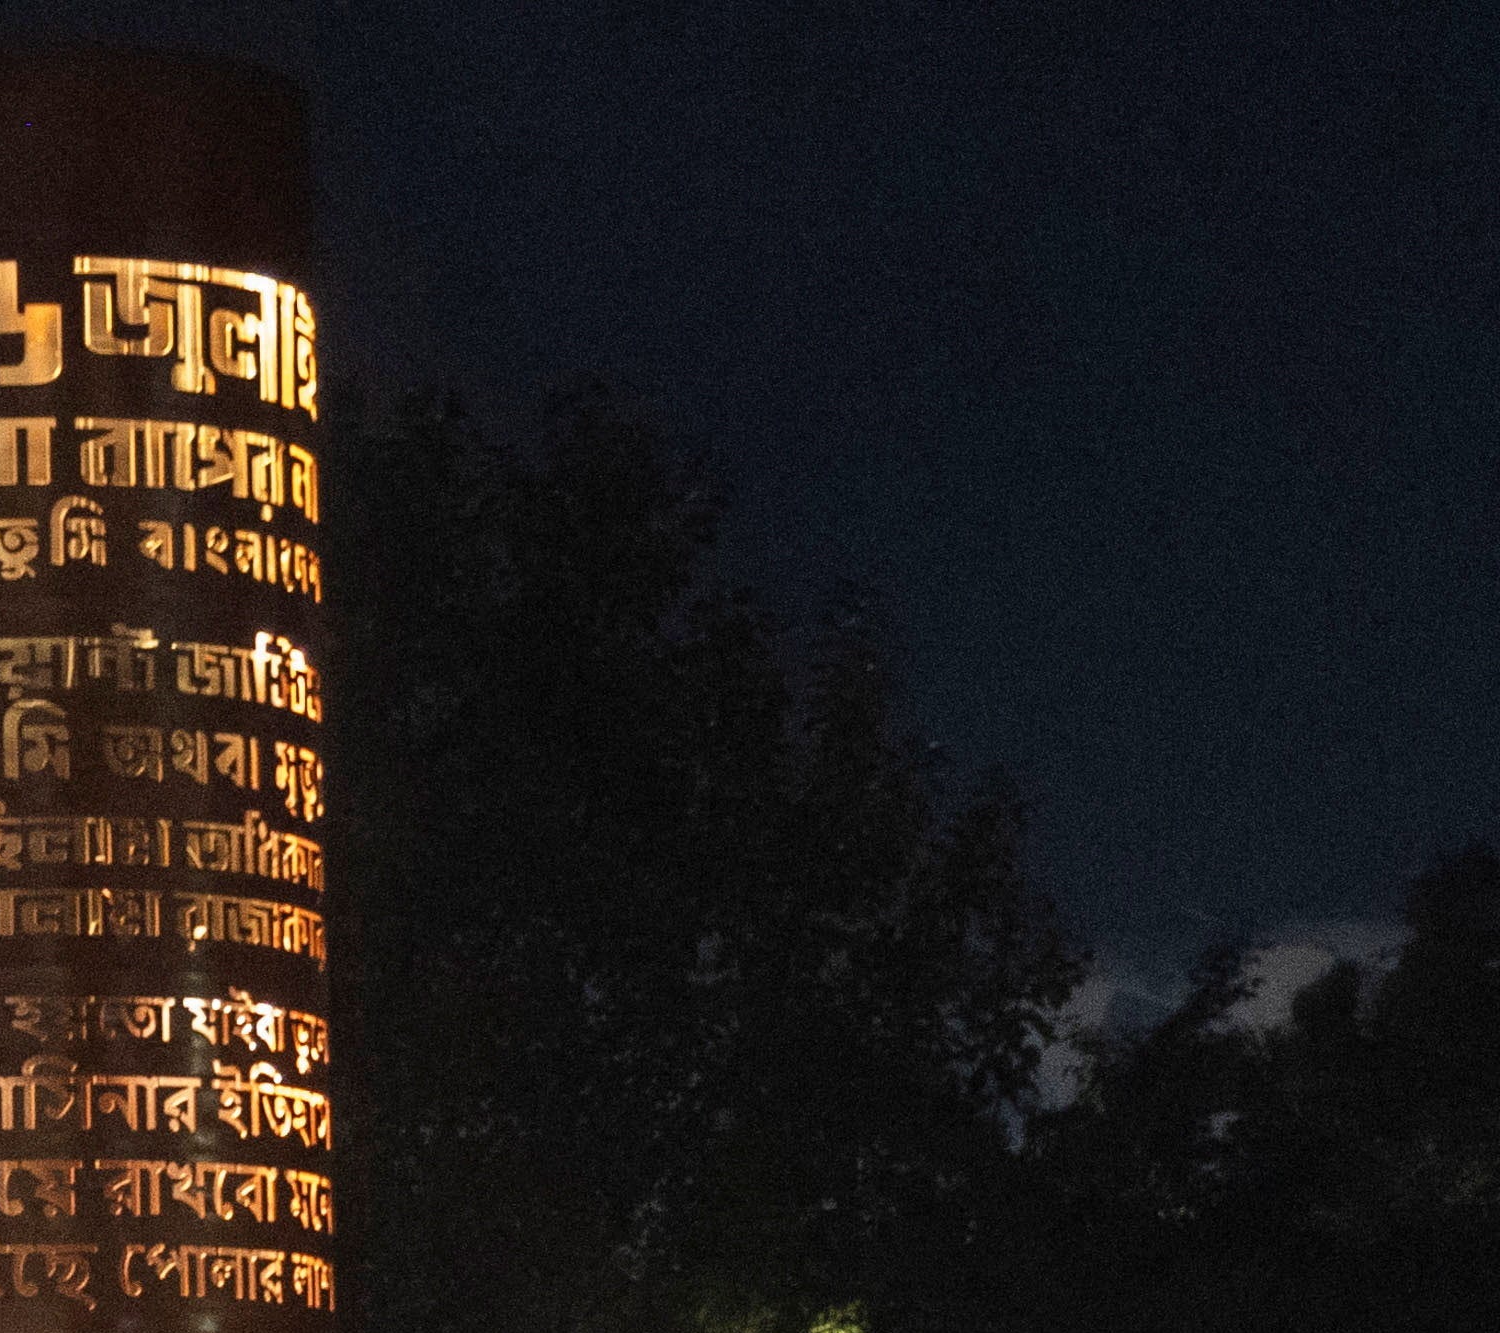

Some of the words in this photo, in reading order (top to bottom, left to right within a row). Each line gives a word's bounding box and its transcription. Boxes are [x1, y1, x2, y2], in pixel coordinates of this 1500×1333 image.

[73, 255, 318, 419] জুলাই
[75, 417, 288, 521] বাপের
[104, 728, 260, 791] অথবা
[211, 1061, 331, 1151] ইতিহাস
[94, 1160, 277, 1224] রাখবো
[120, 1245, 284, 1304] পোলার
